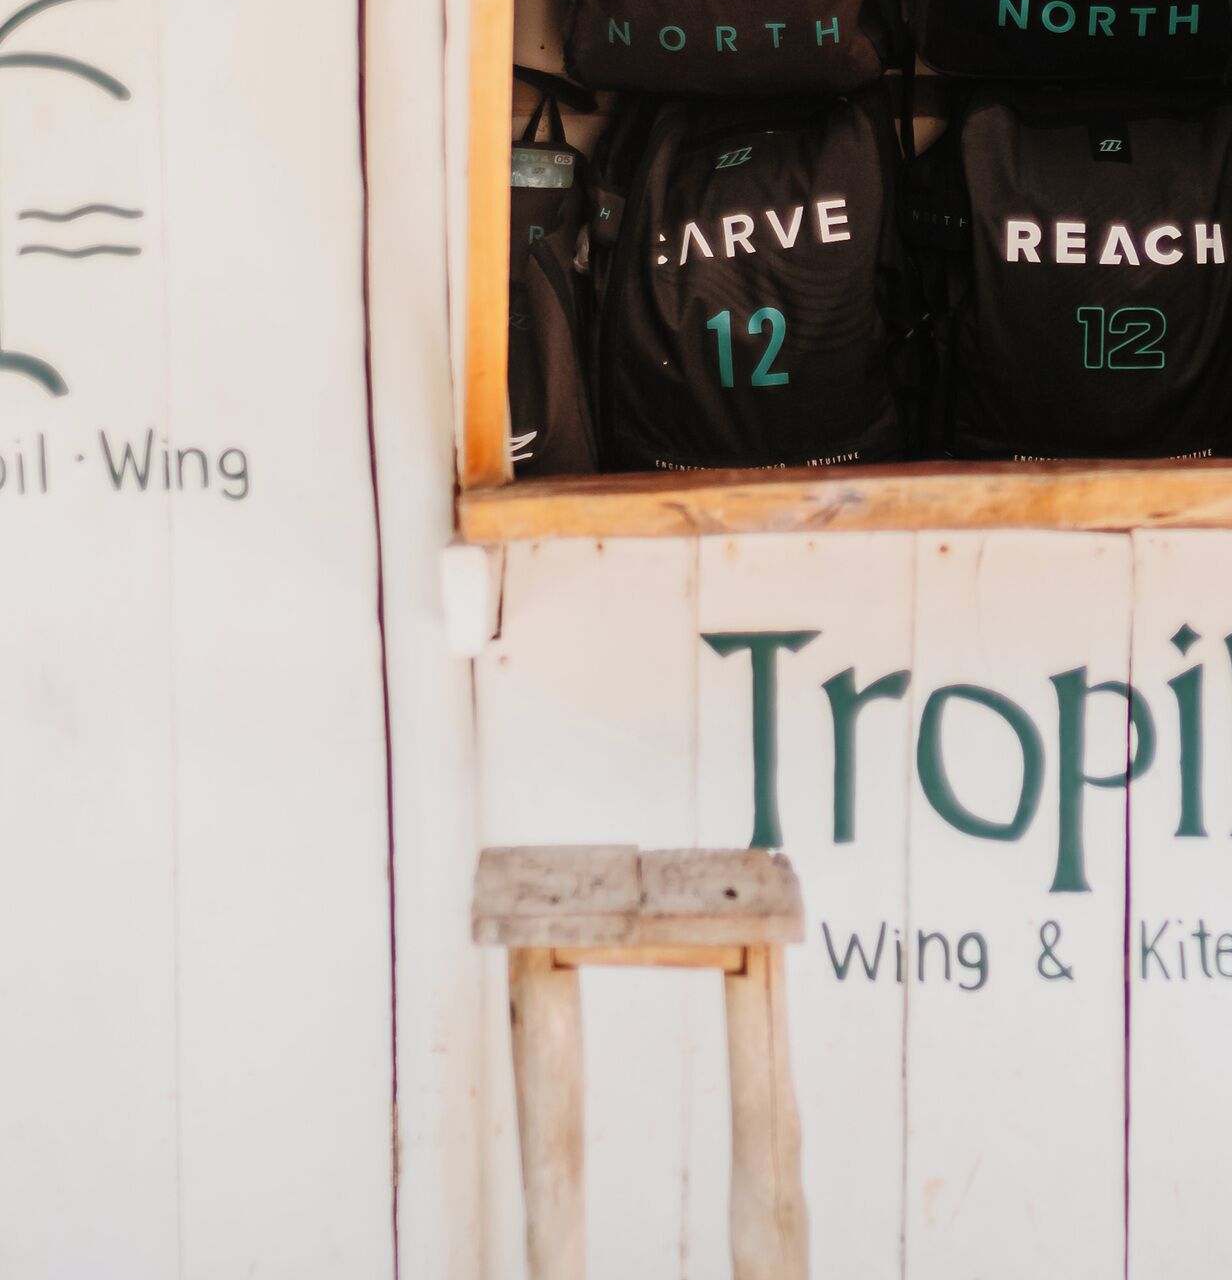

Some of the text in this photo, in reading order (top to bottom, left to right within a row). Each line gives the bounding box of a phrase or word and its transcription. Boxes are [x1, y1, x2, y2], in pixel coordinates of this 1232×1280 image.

[607, 17, 841, 53] NORTH
[656, 199, 851, 266] ARVE
[1005, 220, 1225, 265] REACH
[706, 307, 790, 388] 12
[1076, 307, 1167, 369] 12
[97, 428, 249, 502] Wing
[806, 451, 860, 467] INTUITIVE
[821, 920, 989, 991] Wing
[1037, 919, 1075, 982] &
